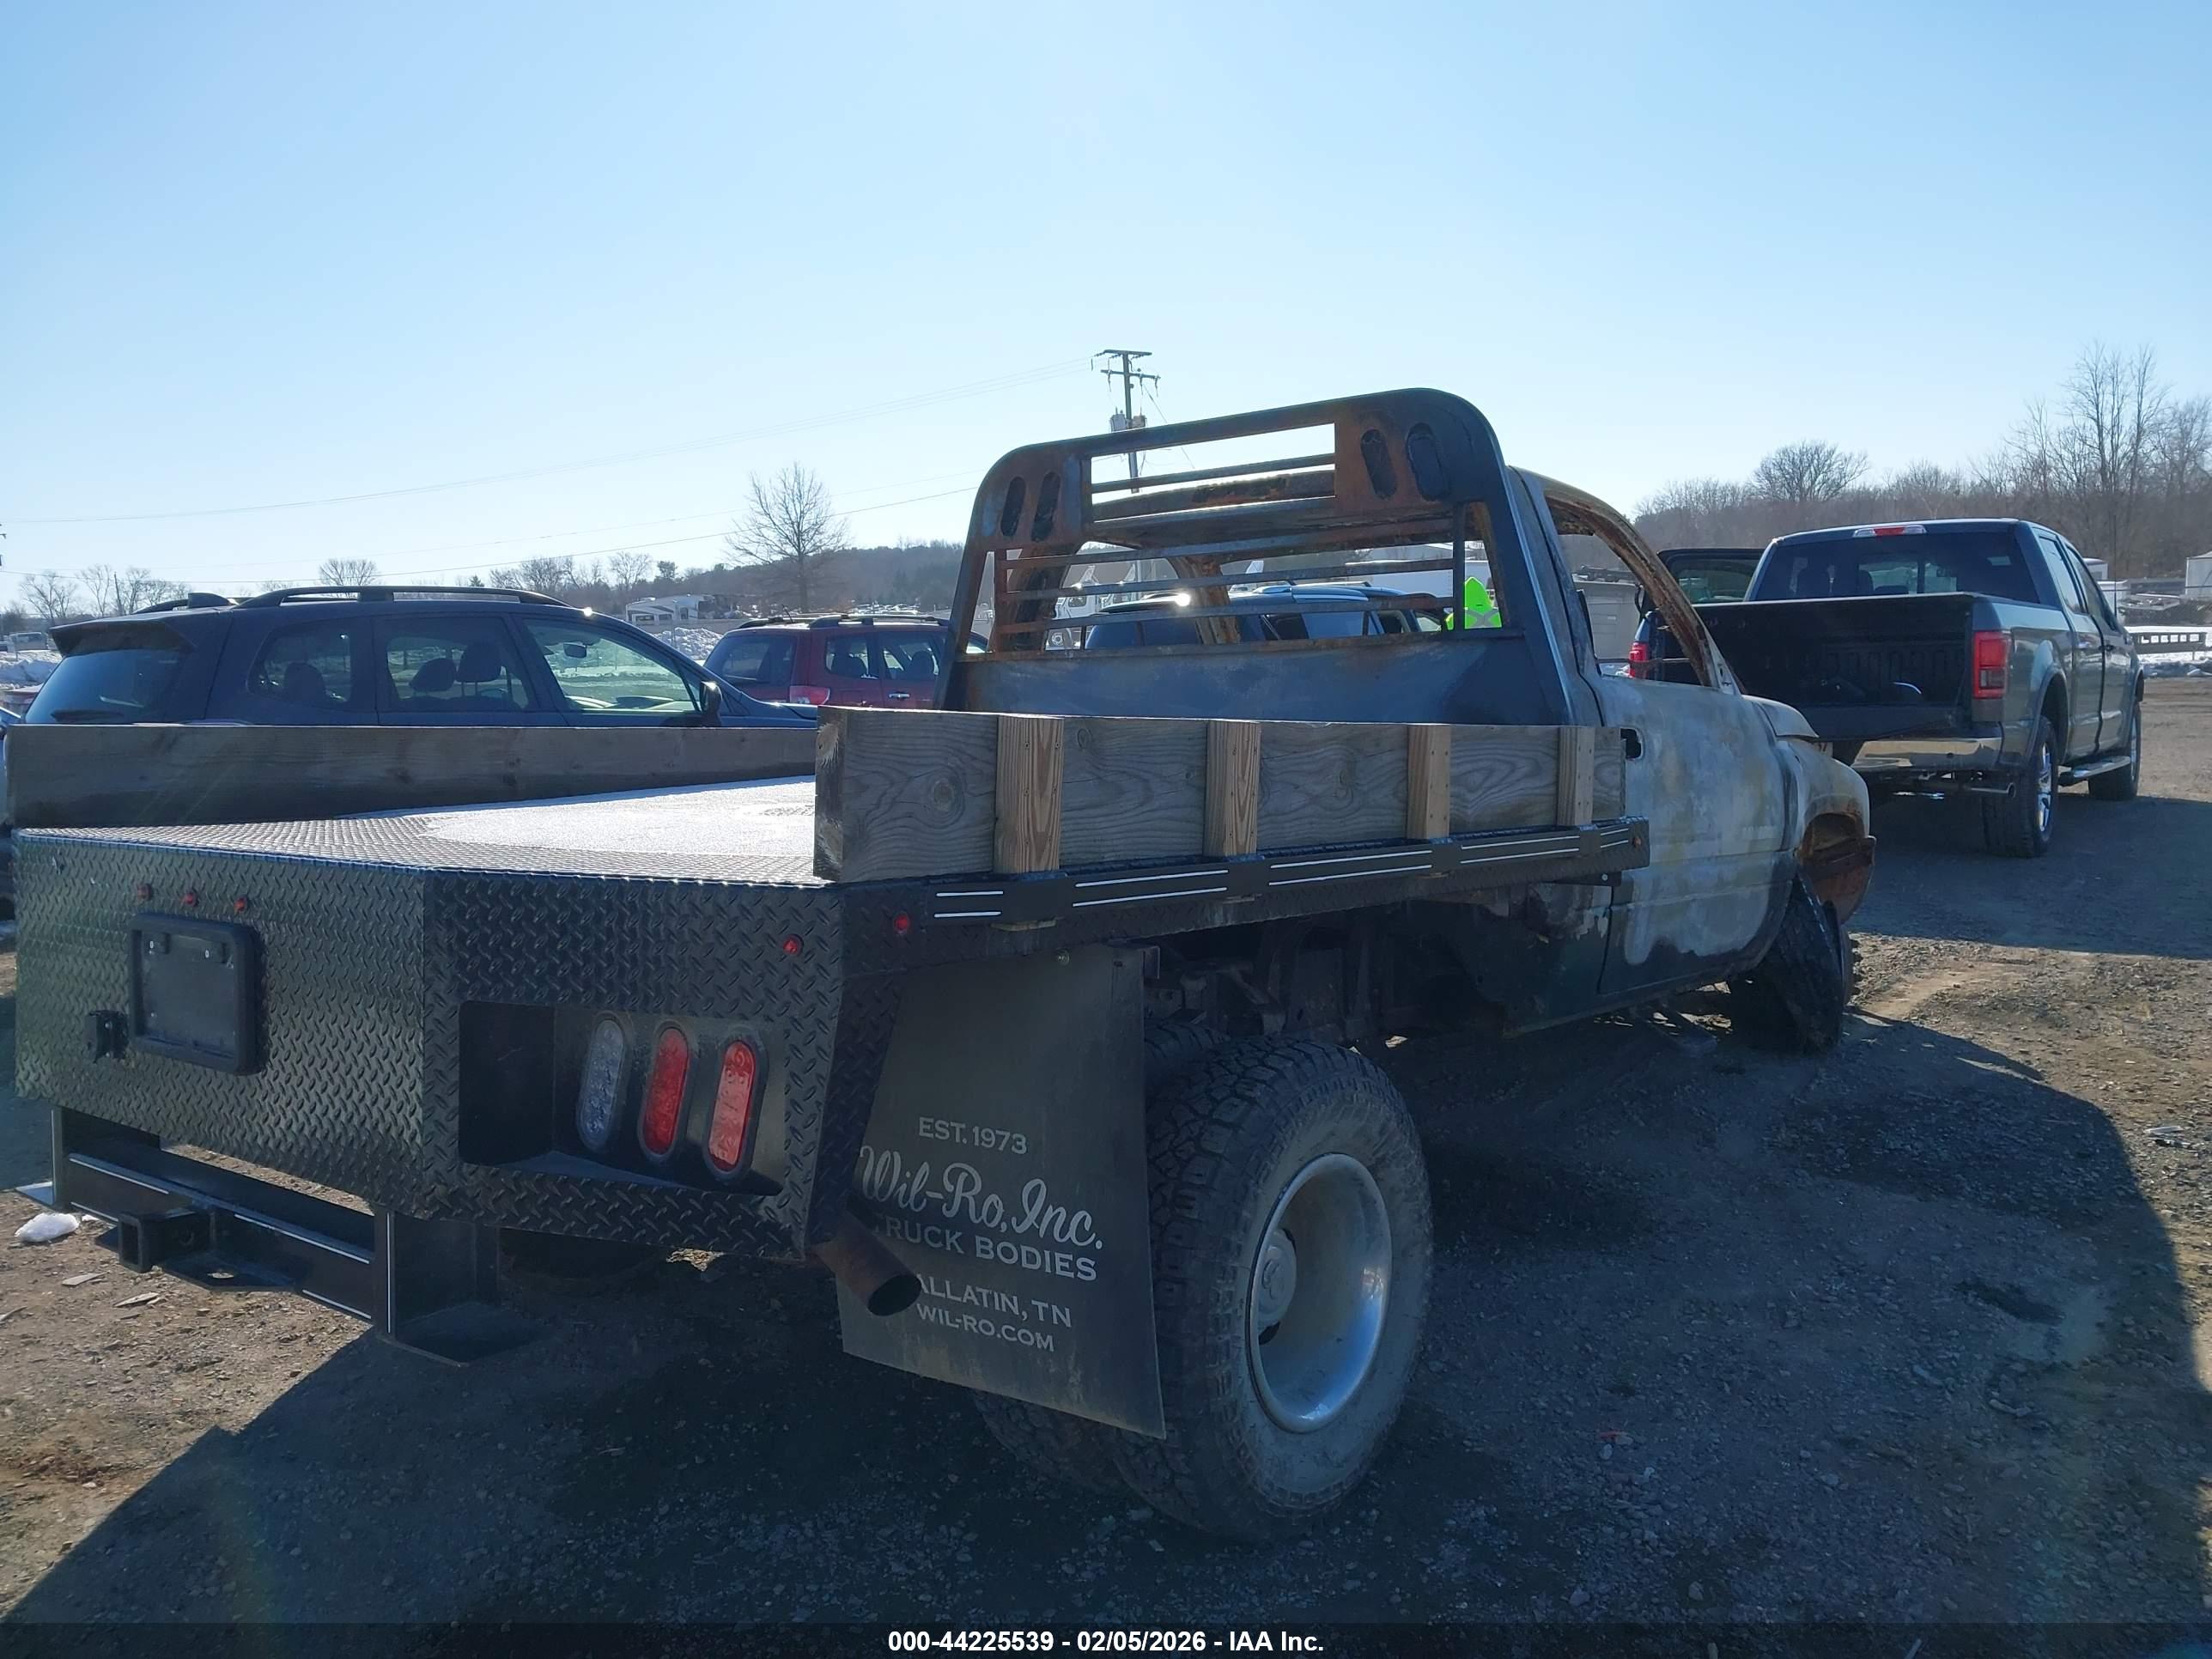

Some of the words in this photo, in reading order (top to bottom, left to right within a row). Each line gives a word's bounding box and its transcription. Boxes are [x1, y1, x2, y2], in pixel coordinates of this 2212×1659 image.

[975, 1236, 1098, 1282] BODIES
[916, 1273, 1028, 1322] LLATIN,
[1030, 1299, 1073, 1328] TN
[916, 1303, 1055, 1352] WIL-RO.COM
